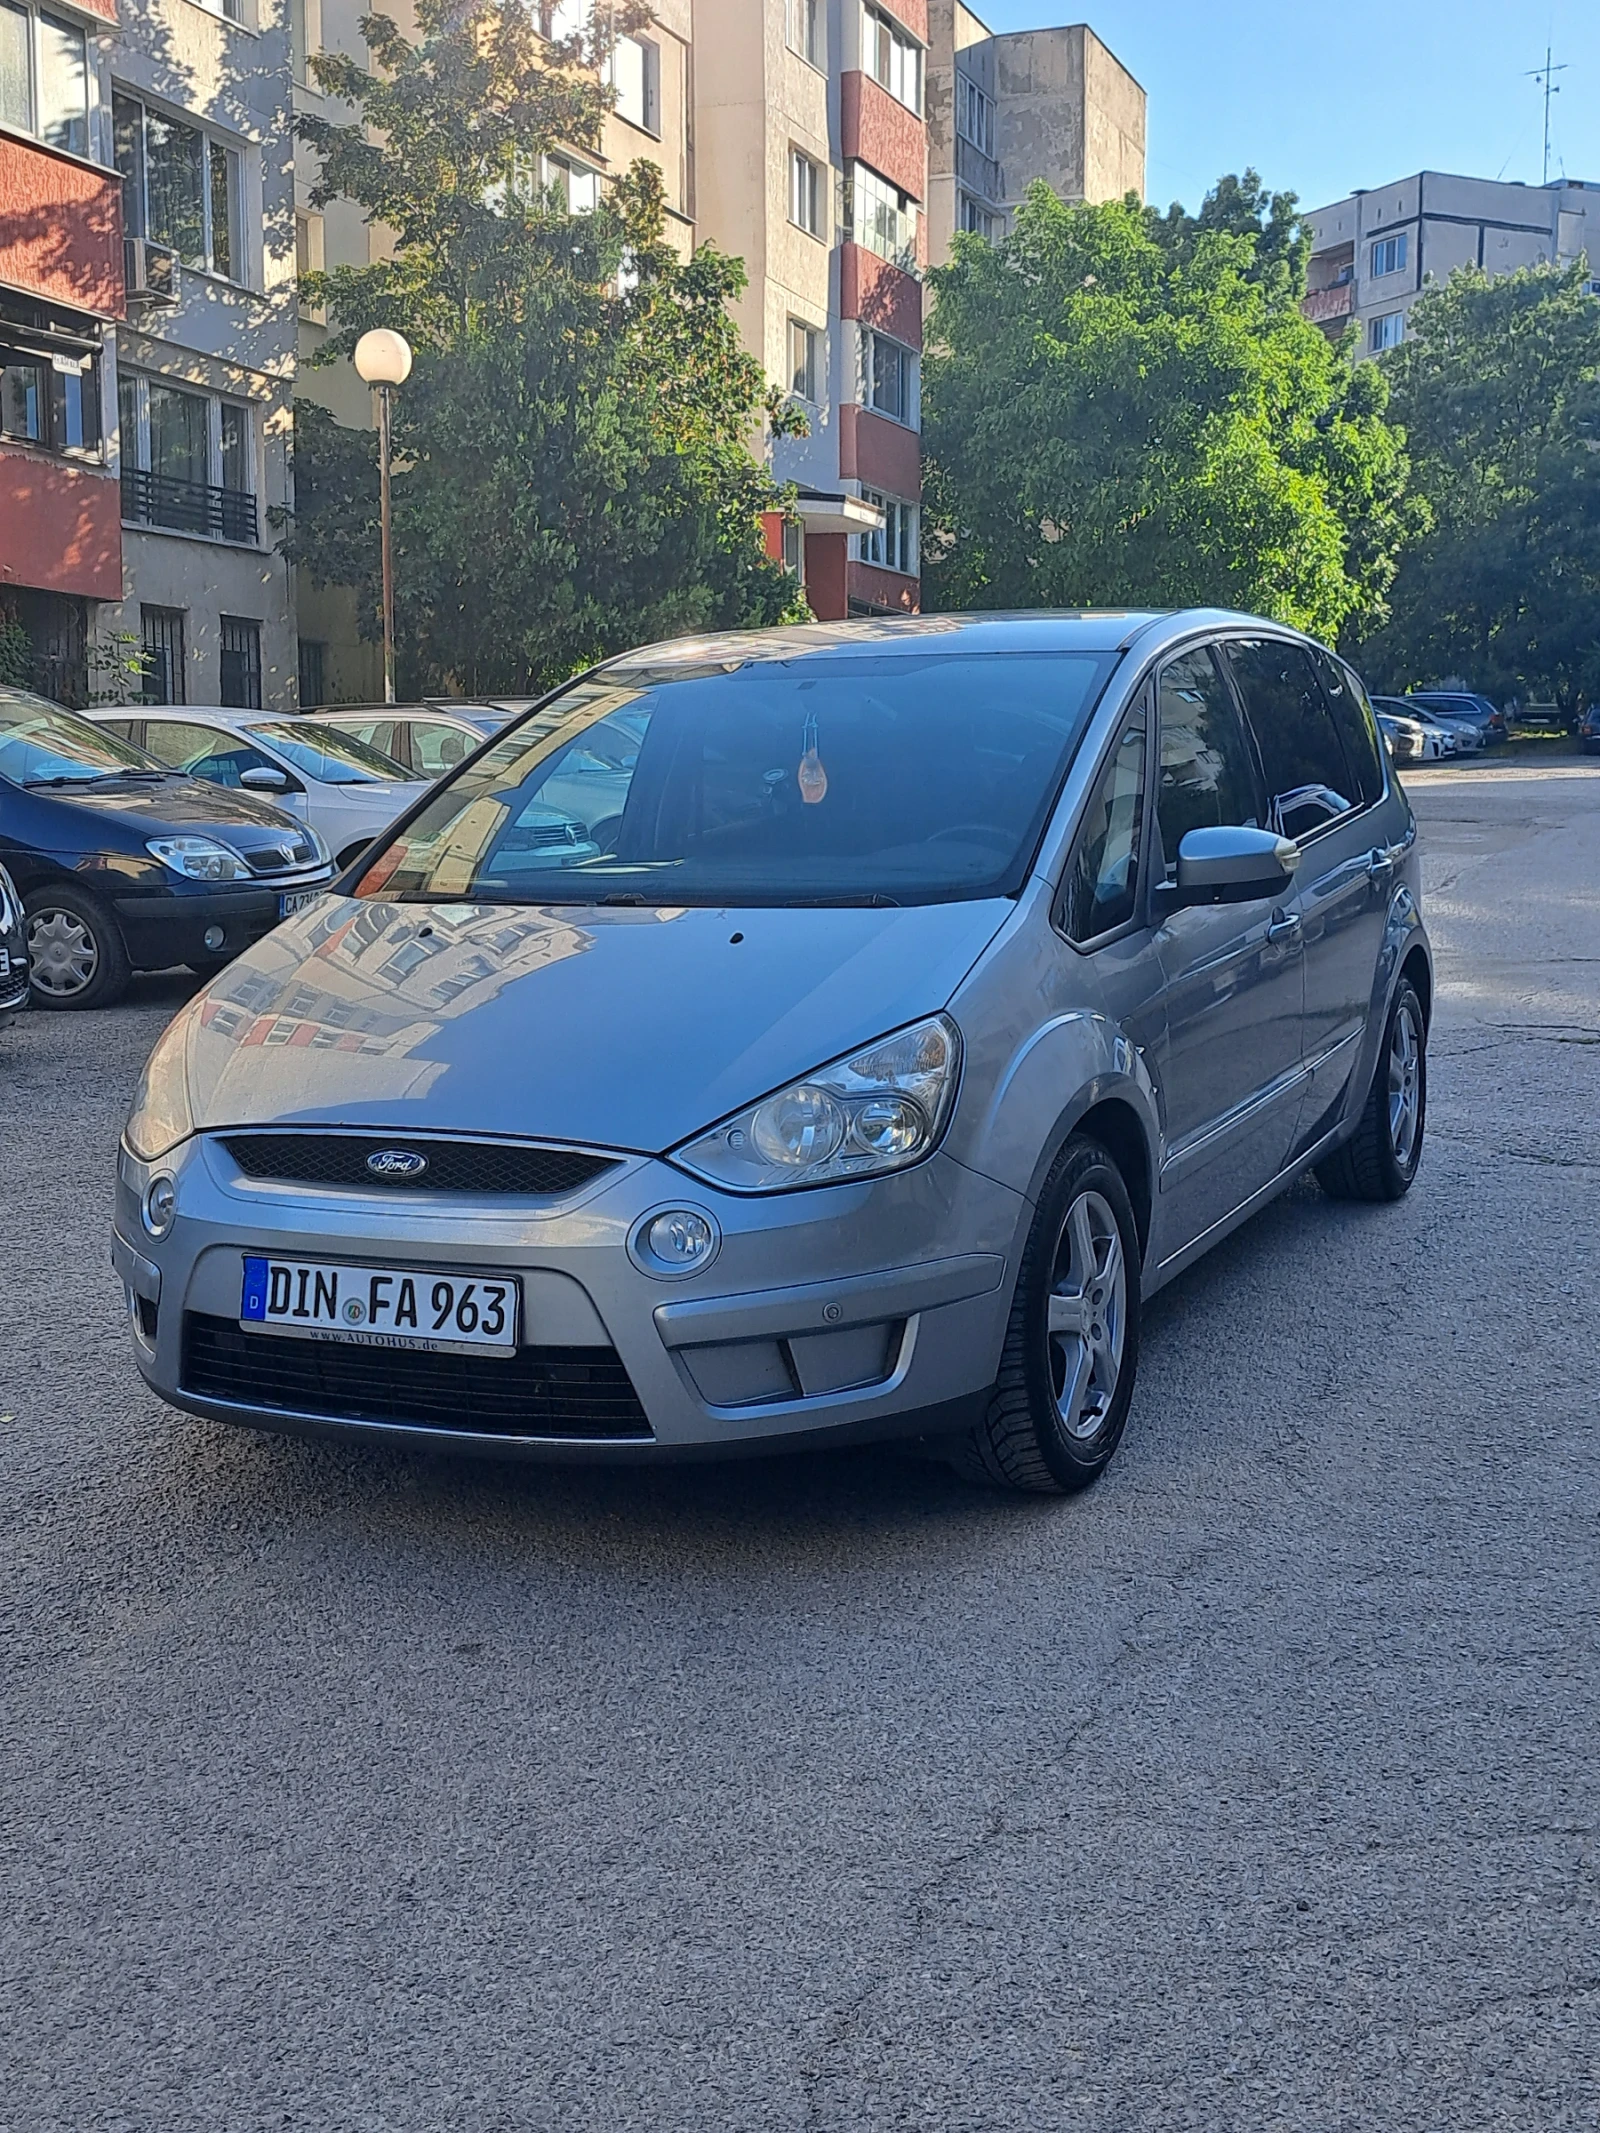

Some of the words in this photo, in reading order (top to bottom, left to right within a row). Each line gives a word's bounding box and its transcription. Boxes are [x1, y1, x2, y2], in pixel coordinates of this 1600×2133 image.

[378, 1154, 413, 1171] Ford
[250, 1295, 259, 1310] D
[268, 1266, 338, 1320] DIN
[368, 1276, 418, 1328] FA
[431, 1281, 506, 1336] 963
[310, 1331, 438, 1351] www.AUTOHUS.de
